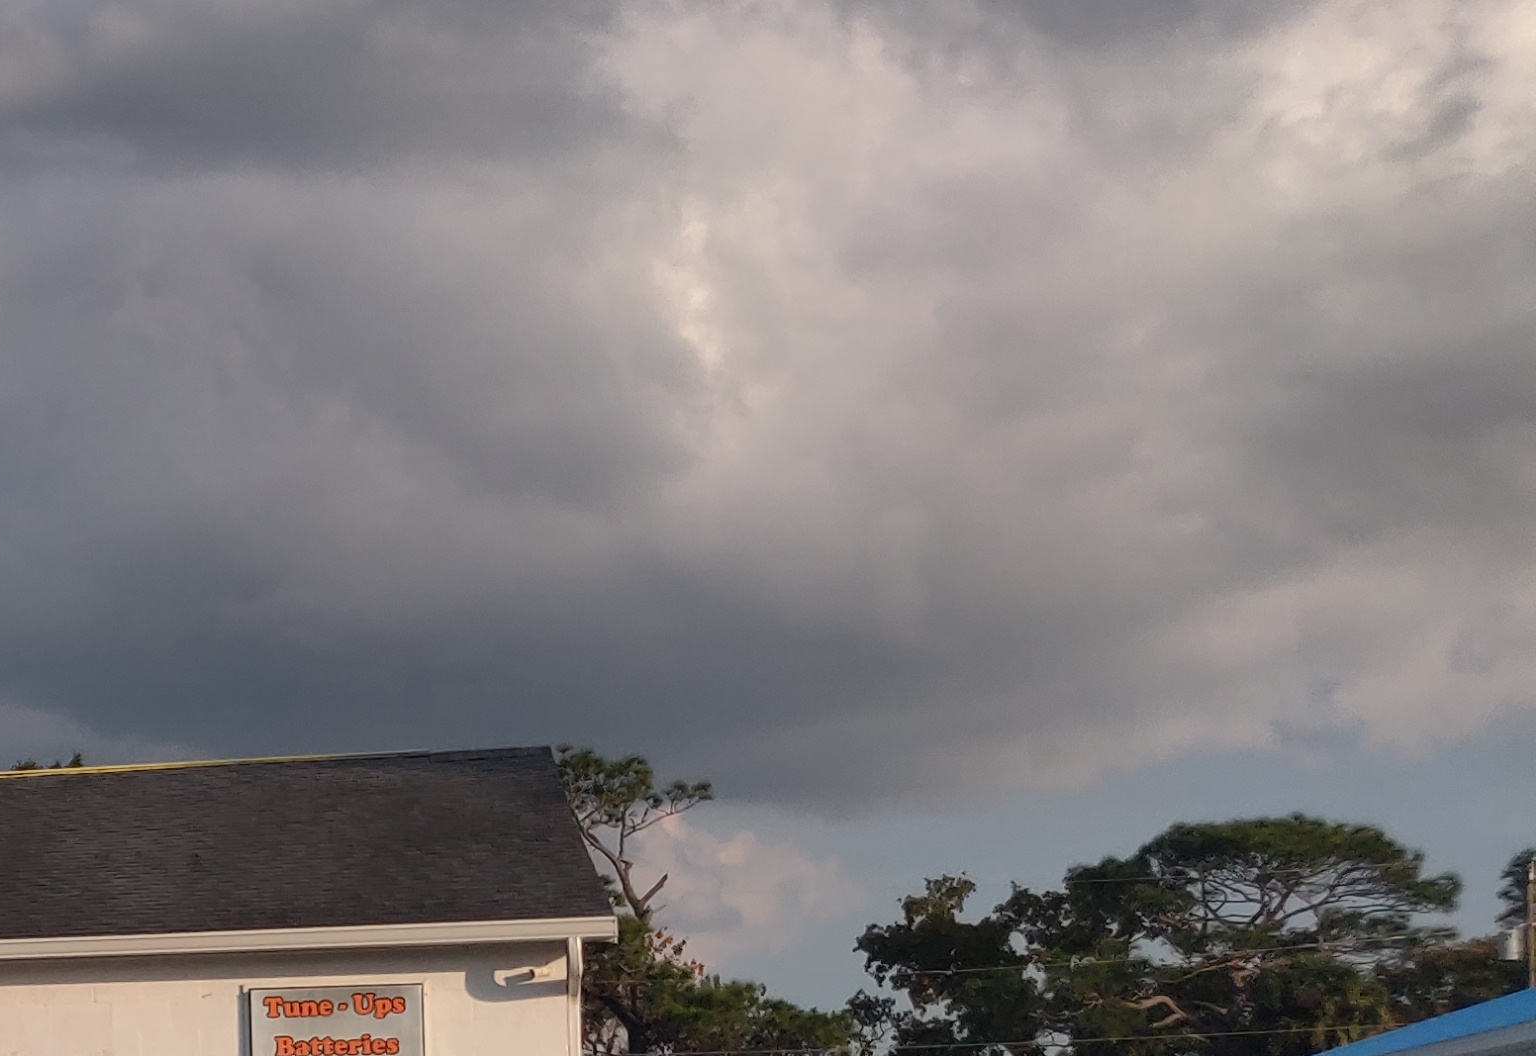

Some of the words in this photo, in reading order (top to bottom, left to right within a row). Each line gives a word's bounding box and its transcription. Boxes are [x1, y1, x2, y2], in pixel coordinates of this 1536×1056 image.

[263, 995, 334, 1018] Tune
[351, 992, 406, 1019] Ups
[274, 1033, 400, 1056] Batteries
